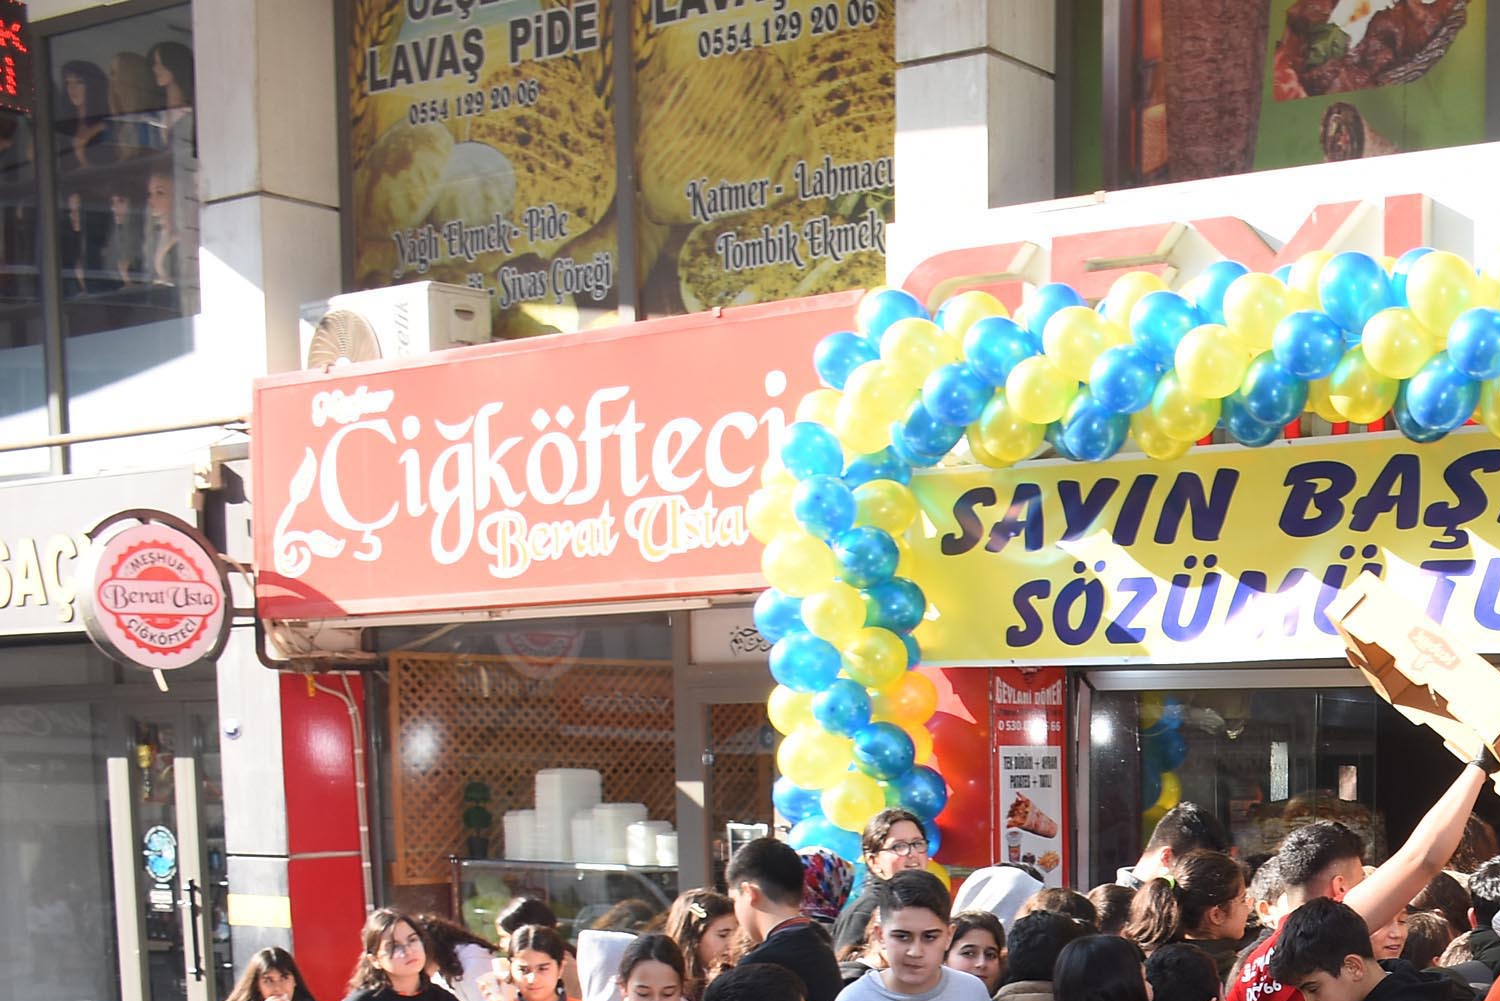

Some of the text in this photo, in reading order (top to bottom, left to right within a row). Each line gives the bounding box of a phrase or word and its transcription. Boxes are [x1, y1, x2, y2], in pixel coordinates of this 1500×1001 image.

[368, 27, 484, 93] LAVAŞ
[699, 23, 752, 58] 0554
[763, 11, 801, 45] 129
[811, 3, 838, 35] 20
[847, 0, 876, 27] 06
[409, 79, 539, 125] 0554 129 20 06
[687, 177, 769, 223] Katmer
[393, 225, 440, 278] Yağlı
[444, 214, 512, 261] Ekmek
[524, 202, 569, 243] Pide
[717, 208, 886, 271] Tombik Ekmek
[500, 265, 547, 309] Sivas
[552, 251, 614, 305] Çöreği
[320, 369, 788, 566] Çiğköfteci
[478, 489, 750, 579] Berat Usta
[940, 468, 1240, 556] SAYIN
[103, 583, 214, 610] Berat Usta
[1005, 545, 1383, 648] SÖZÜMÜ
